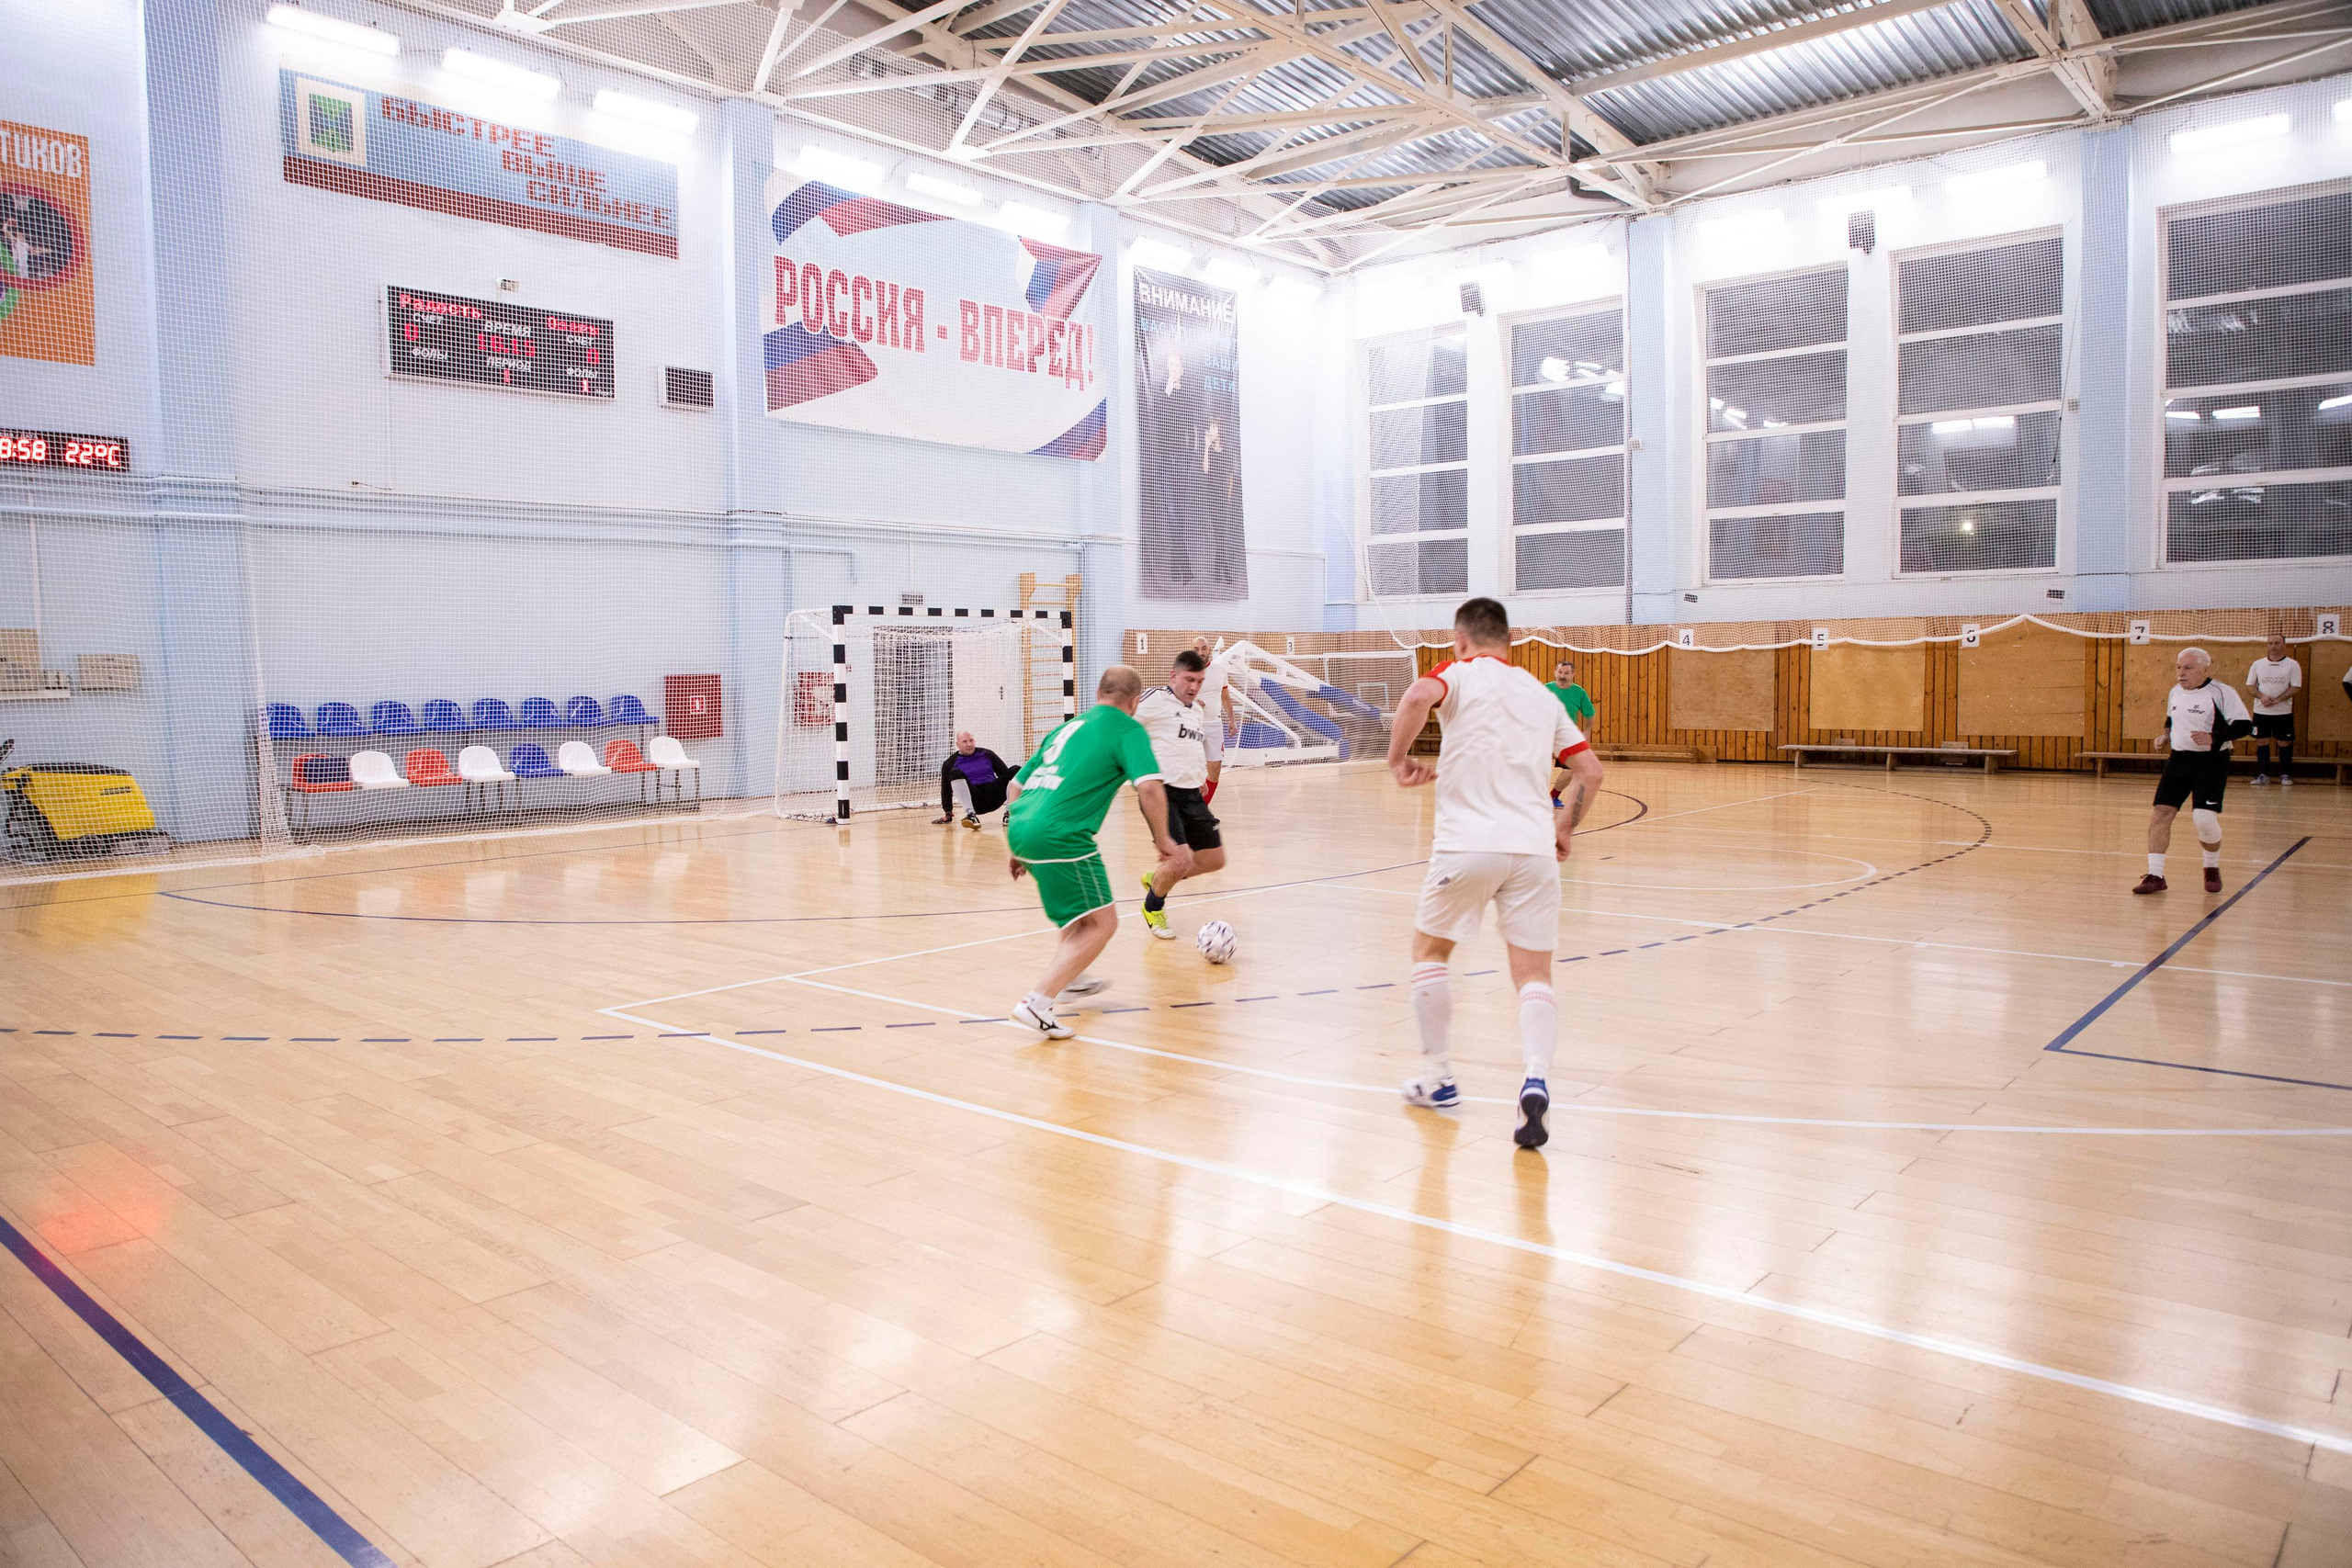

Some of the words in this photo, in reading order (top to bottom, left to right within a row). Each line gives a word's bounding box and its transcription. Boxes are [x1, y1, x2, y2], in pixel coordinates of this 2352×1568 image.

[381, 96, 555, 157] БЫСТРЕЕ
[502, 149, 606, 193] ВЫШЕ
[1138, 283, 1234, 322] ВНИМАНИЕ
[484, 321, 532, 337] ВРЕМЯ
[774, 254, 926, 354] РОССИЯ
[959, 299, 1094, 391] ВПЕРЕД!
[567, 335, 594, 346] СЧЕТ
[412, 348, 448, 360] ФОЛЫ
[487, 356, 532, 373] ПЕРИОД
[566, 367, 598, 379] ФОЛЫ
[1682, 634, 1690, 646] 4
[1966, 630, 1975, 643] 6
[2134, 626, 2145, 640] 7
